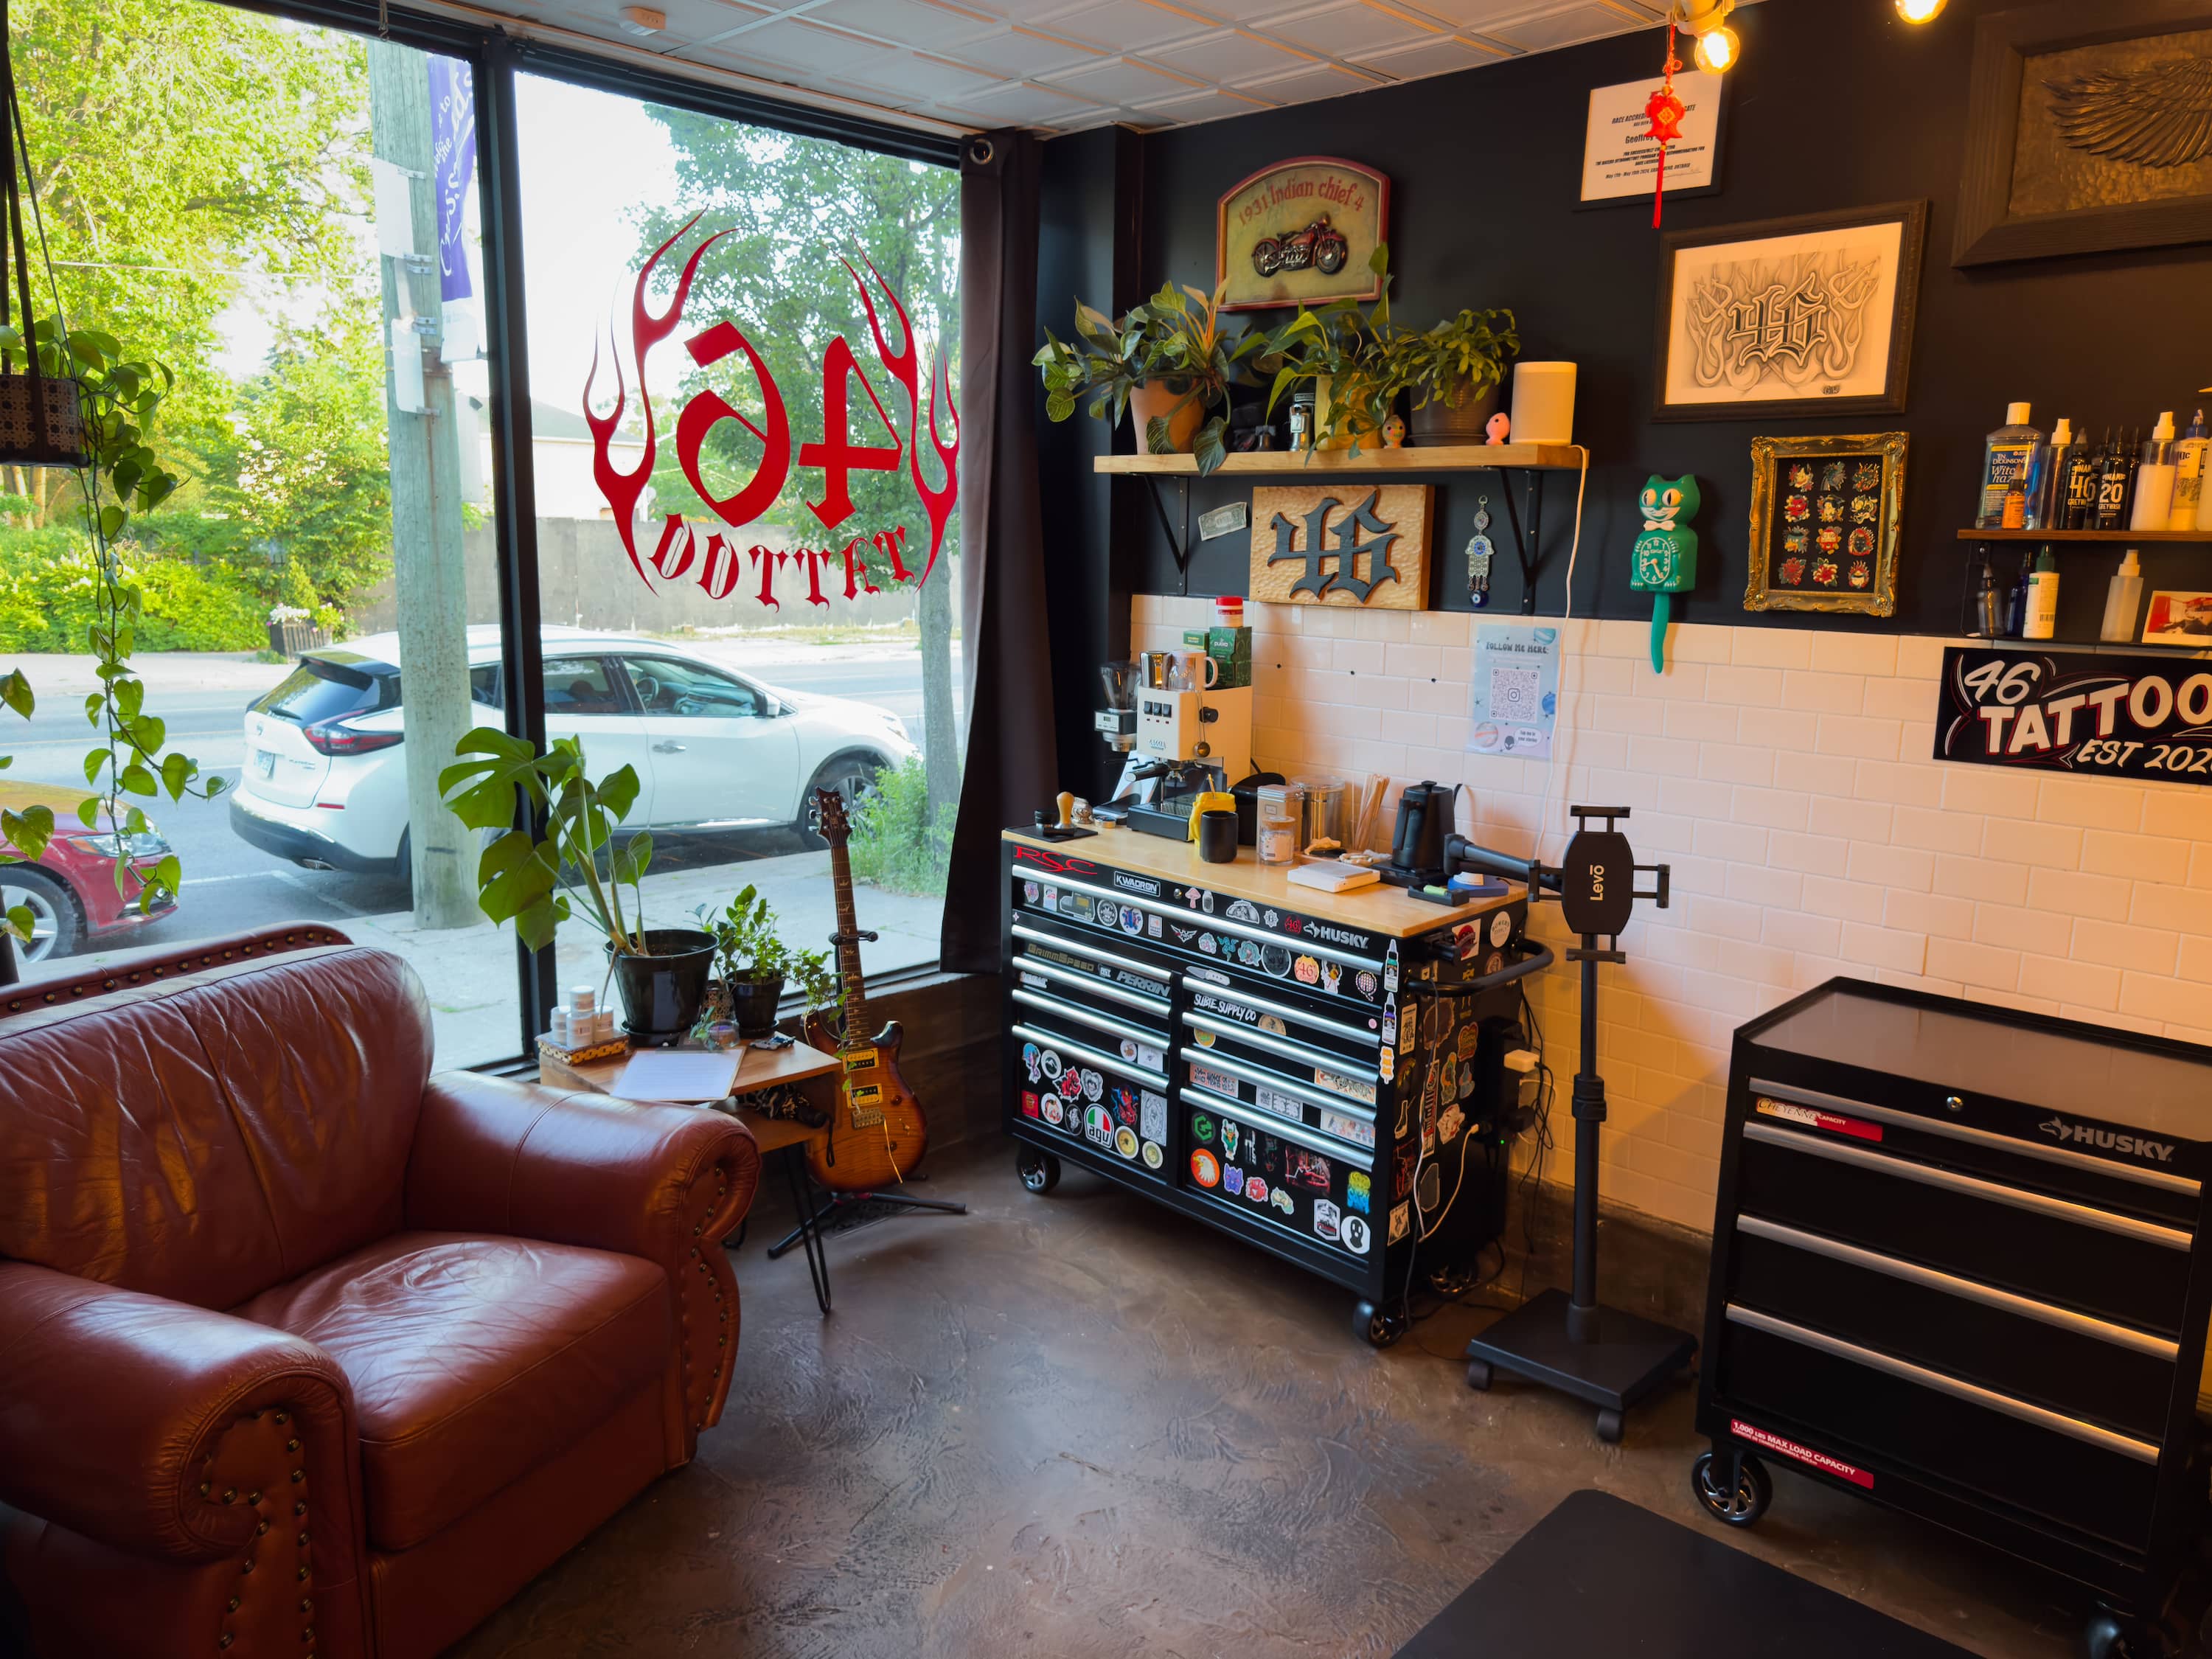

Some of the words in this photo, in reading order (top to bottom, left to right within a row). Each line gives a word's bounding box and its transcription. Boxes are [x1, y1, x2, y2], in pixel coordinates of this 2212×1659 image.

[1239, 194, 1269, 226] 1931
[1270, 178, 1314, 206] Indian
[1318, 176, 1357, 206] chief
[1354, 195, 1365, 212] 4
[1992, 465, 2016, 476] Witc
[1992, 474, 2012, 484] haz
[2099, 483, 2123, 504] 20
[1486, 641, 1512, 651] FOLLOW
[1514, 644, 1526, 653] ME
[1964, 660, 2042, 705] 46
[1977, 672, 2212, 756] TATTOO
[2076, 738, 2144, 768] EST
[2144, 744, 2212, 774] 202
[1116, 874, 1158, 894] KWADRON
[1320, 926, 1370, 949] HUSKY
[1299, 962, 1314, 977] 46
[1116, 970, 1171, 997] PERRIN
[1194, 994, 1217, 1010] SUBIE
[1217, 1001, 1246, 1022] SUPPLY
[1758, 1098, 1817, 1120] CHEYENNE
[1818, 1114, 1847, 1126] CAPACITY
[1089, 1125, 1110, 1143] agv
[2073, 1124, 2175, 1161] HUSKY
[1733, 1422, 1755, 1436] 1,000
[1755, 1431, 1767, 1440] LBS
[1767, 1435, 1788, 1449] MAX
[1789, 1444, 1812, 1458] LOAD
[1814, 1454, 1856, 1475] CAPACITY
